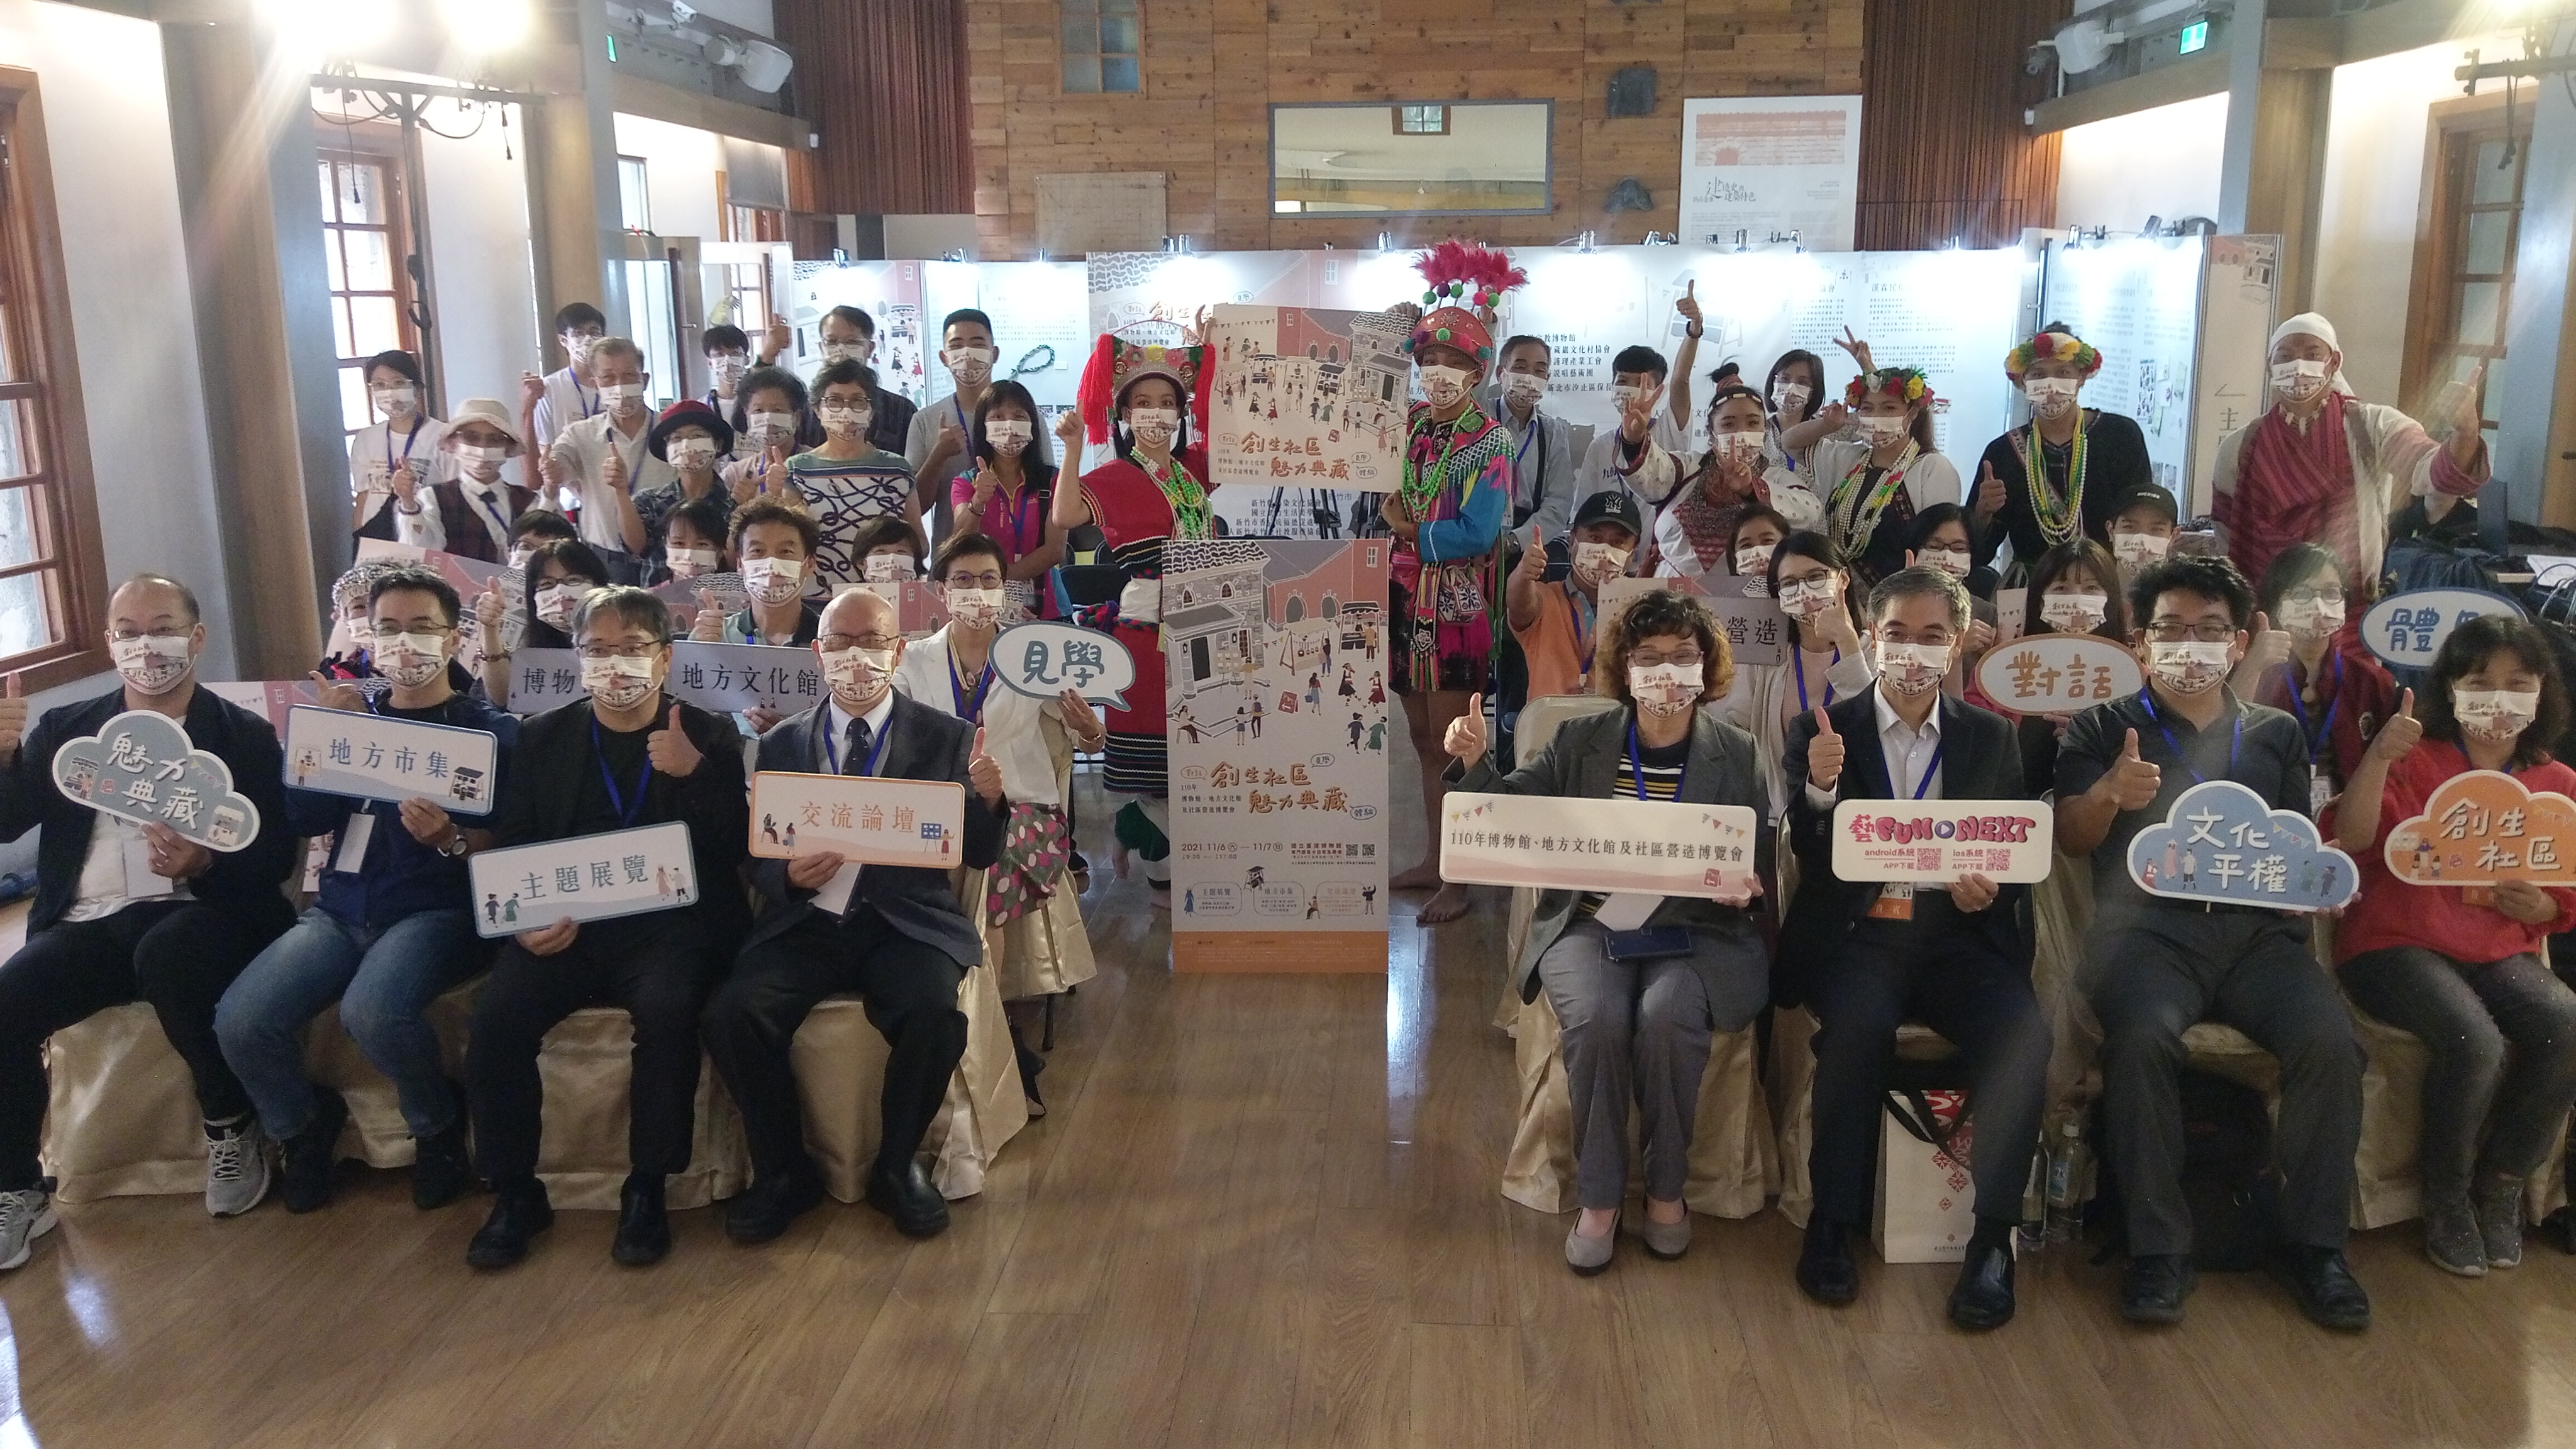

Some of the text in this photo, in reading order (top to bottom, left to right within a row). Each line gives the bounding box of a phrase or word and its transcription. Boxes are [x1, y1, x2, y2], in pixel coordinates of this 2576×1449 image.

[1241, 430, 1322, 455] 創生社區
[1270, 456, 1351, 481] 魅力典藏
[1726, 616, 1779, 646] 營造
[682, 663, 819, 697] 地方文化館
[1023, 639, 1105, 689] 見學
[2005, 650, 2112, 699] 對話
[107, 731, 187, 781] 魅力
[328, 737, 449, 779] 地方市集
[1209, 760, 1312, 789] 創生社區
[121, 777, 204, 830] 典藏
[799, 800, 916, 834] 交流論壇
[1248, 786, 1348, 814] 魅力典藏
[2439, 797, 2526, 840] 創生
[1450, 828, 1743, 863] 110年博物館、地方文化館及社區營造博覽會
[1955, 816, 2036, 843] NEXT
[2185, 806, 2270, 849] 文化
[2474, 835, 2562, 873] 社區
[520, 854, 649, 901] 主題展覽
[2207, 853, 2287, 894] 平權
